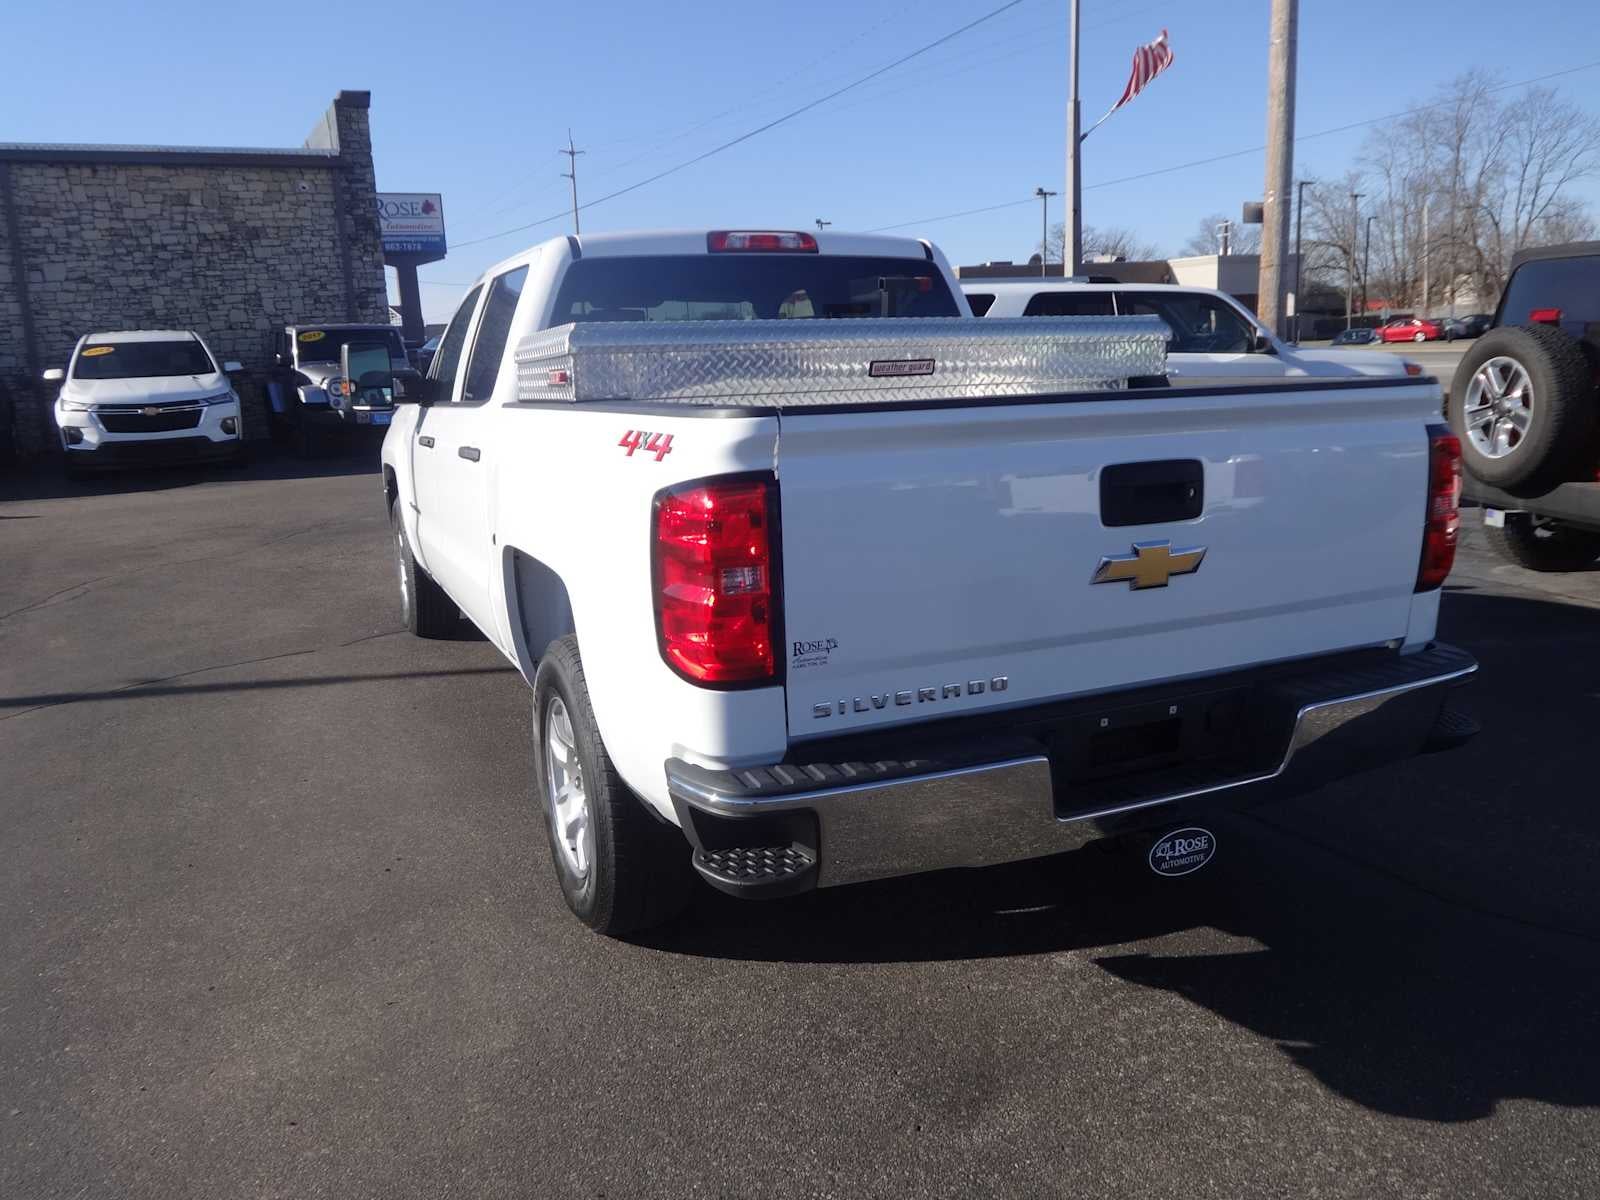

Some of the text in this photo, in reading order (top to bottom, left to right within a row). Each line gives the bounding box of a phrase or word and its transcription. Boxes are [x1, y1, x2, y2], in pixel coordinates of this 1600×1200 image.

[793, 640, 823, 656] ROSE
[812, 675, 1009, 719] SILVERADO
[1174, 836, 1208, 856] ROSE
[1160, 854, 1205, 870] AUTOMOTIVE
